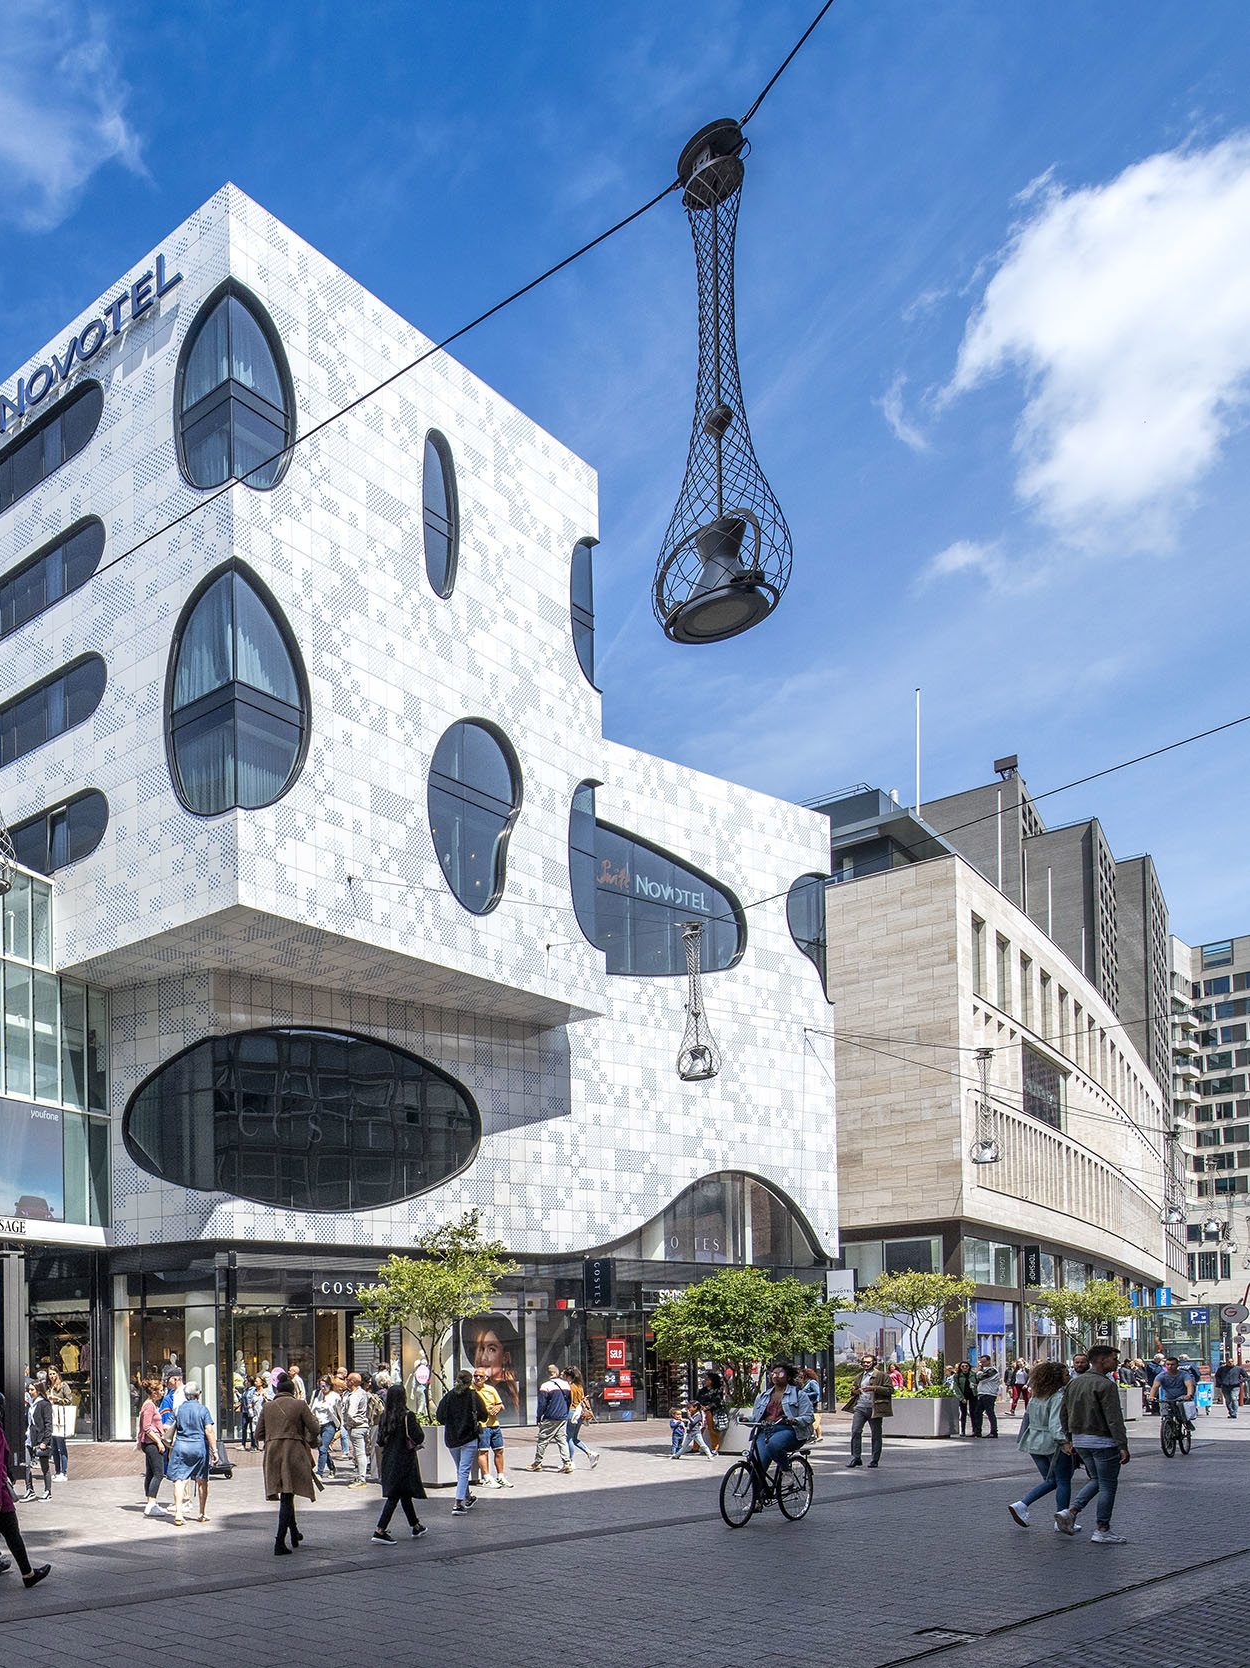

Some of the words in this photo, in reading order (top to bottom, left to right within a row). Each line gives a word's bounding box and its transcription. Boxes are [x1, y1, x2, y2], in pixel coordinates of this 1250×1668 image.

[0, 253, 184, 434] NOVOTEL
[635, 874, 710, 912] NOVOTEL
[30, 1109, 59, 1122] youfone
[669, 1235, 721, 1251] OTES
[1028, 1253, 1036, 1281] TOPSHOP
[593, 1262, 601, 1305] COSTES
[1190, 1311, 1199, 1321] P
